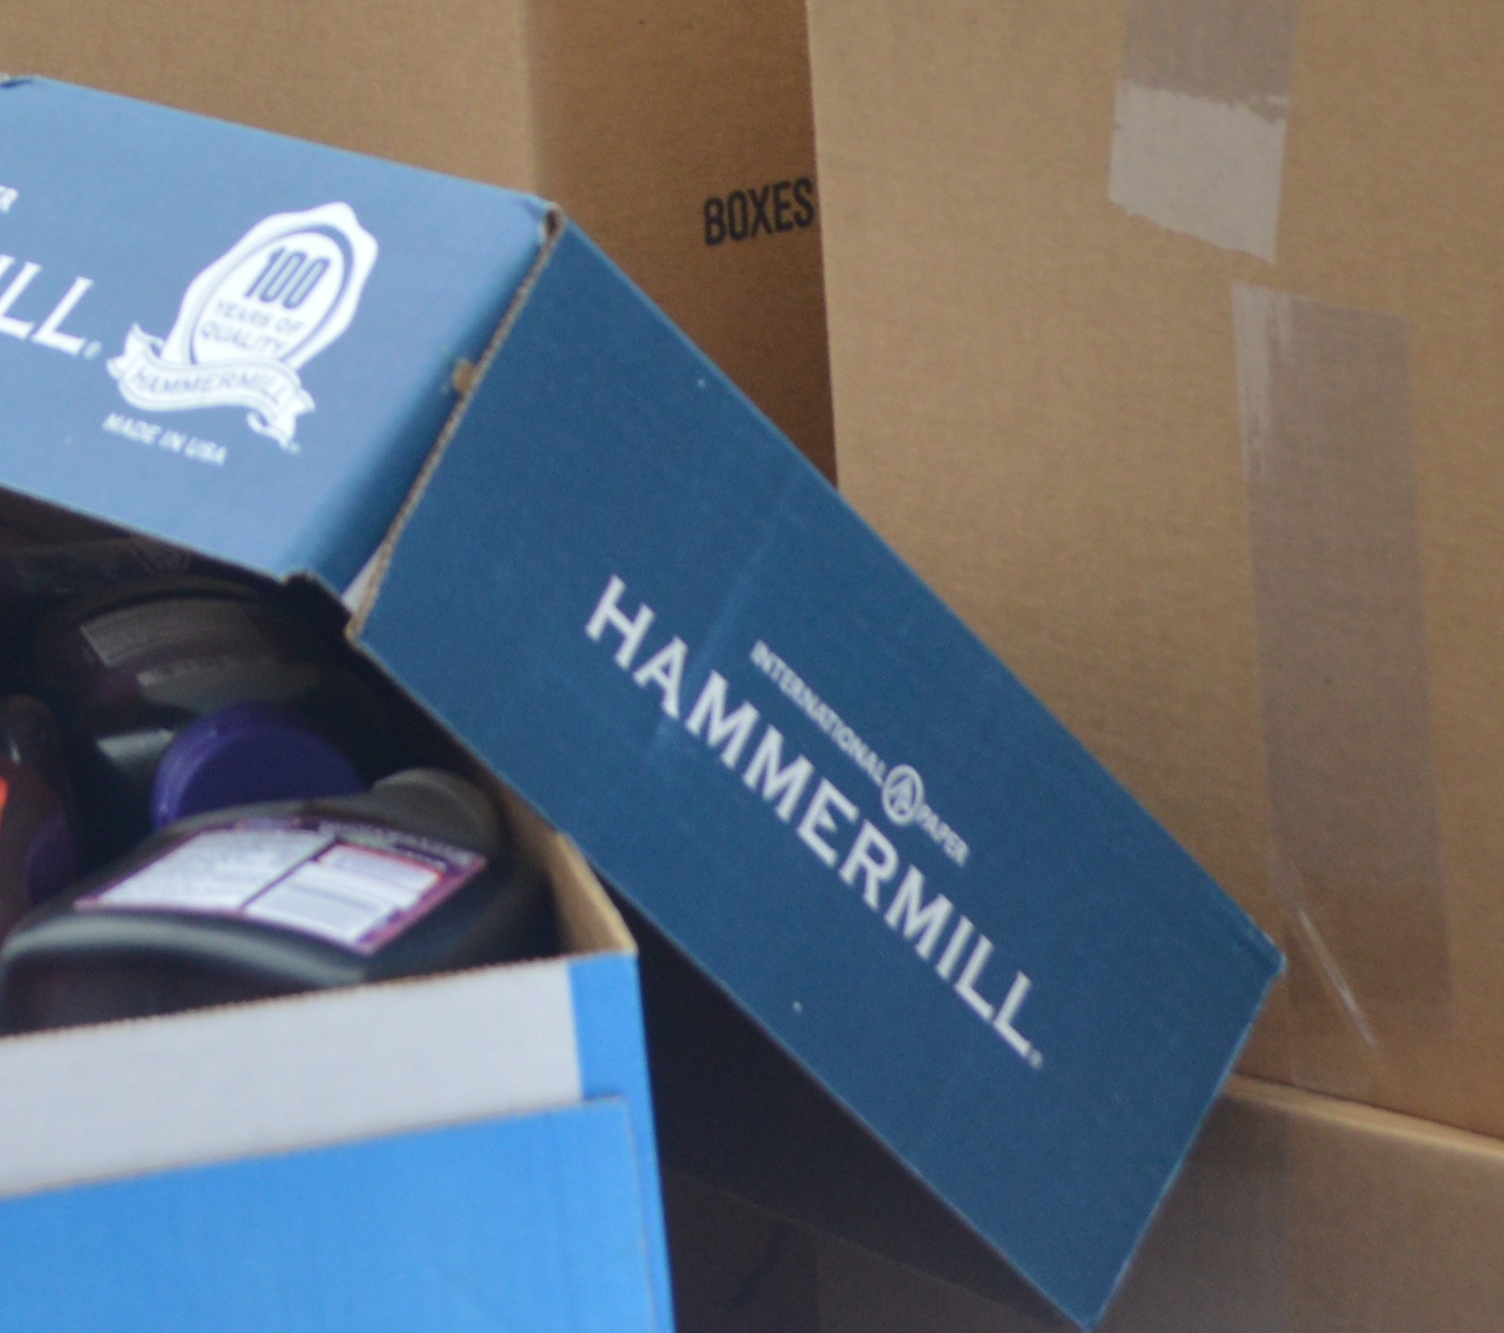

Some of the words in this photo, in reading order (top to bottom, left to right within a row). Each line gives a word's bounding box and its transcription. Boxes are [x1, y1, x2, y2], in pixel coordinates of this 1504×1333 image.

[704, 176, 816, 247] BOXES
[244, 247, 330, 309] 100
[584, 574, 1037, 1061] HAMMERMILL
